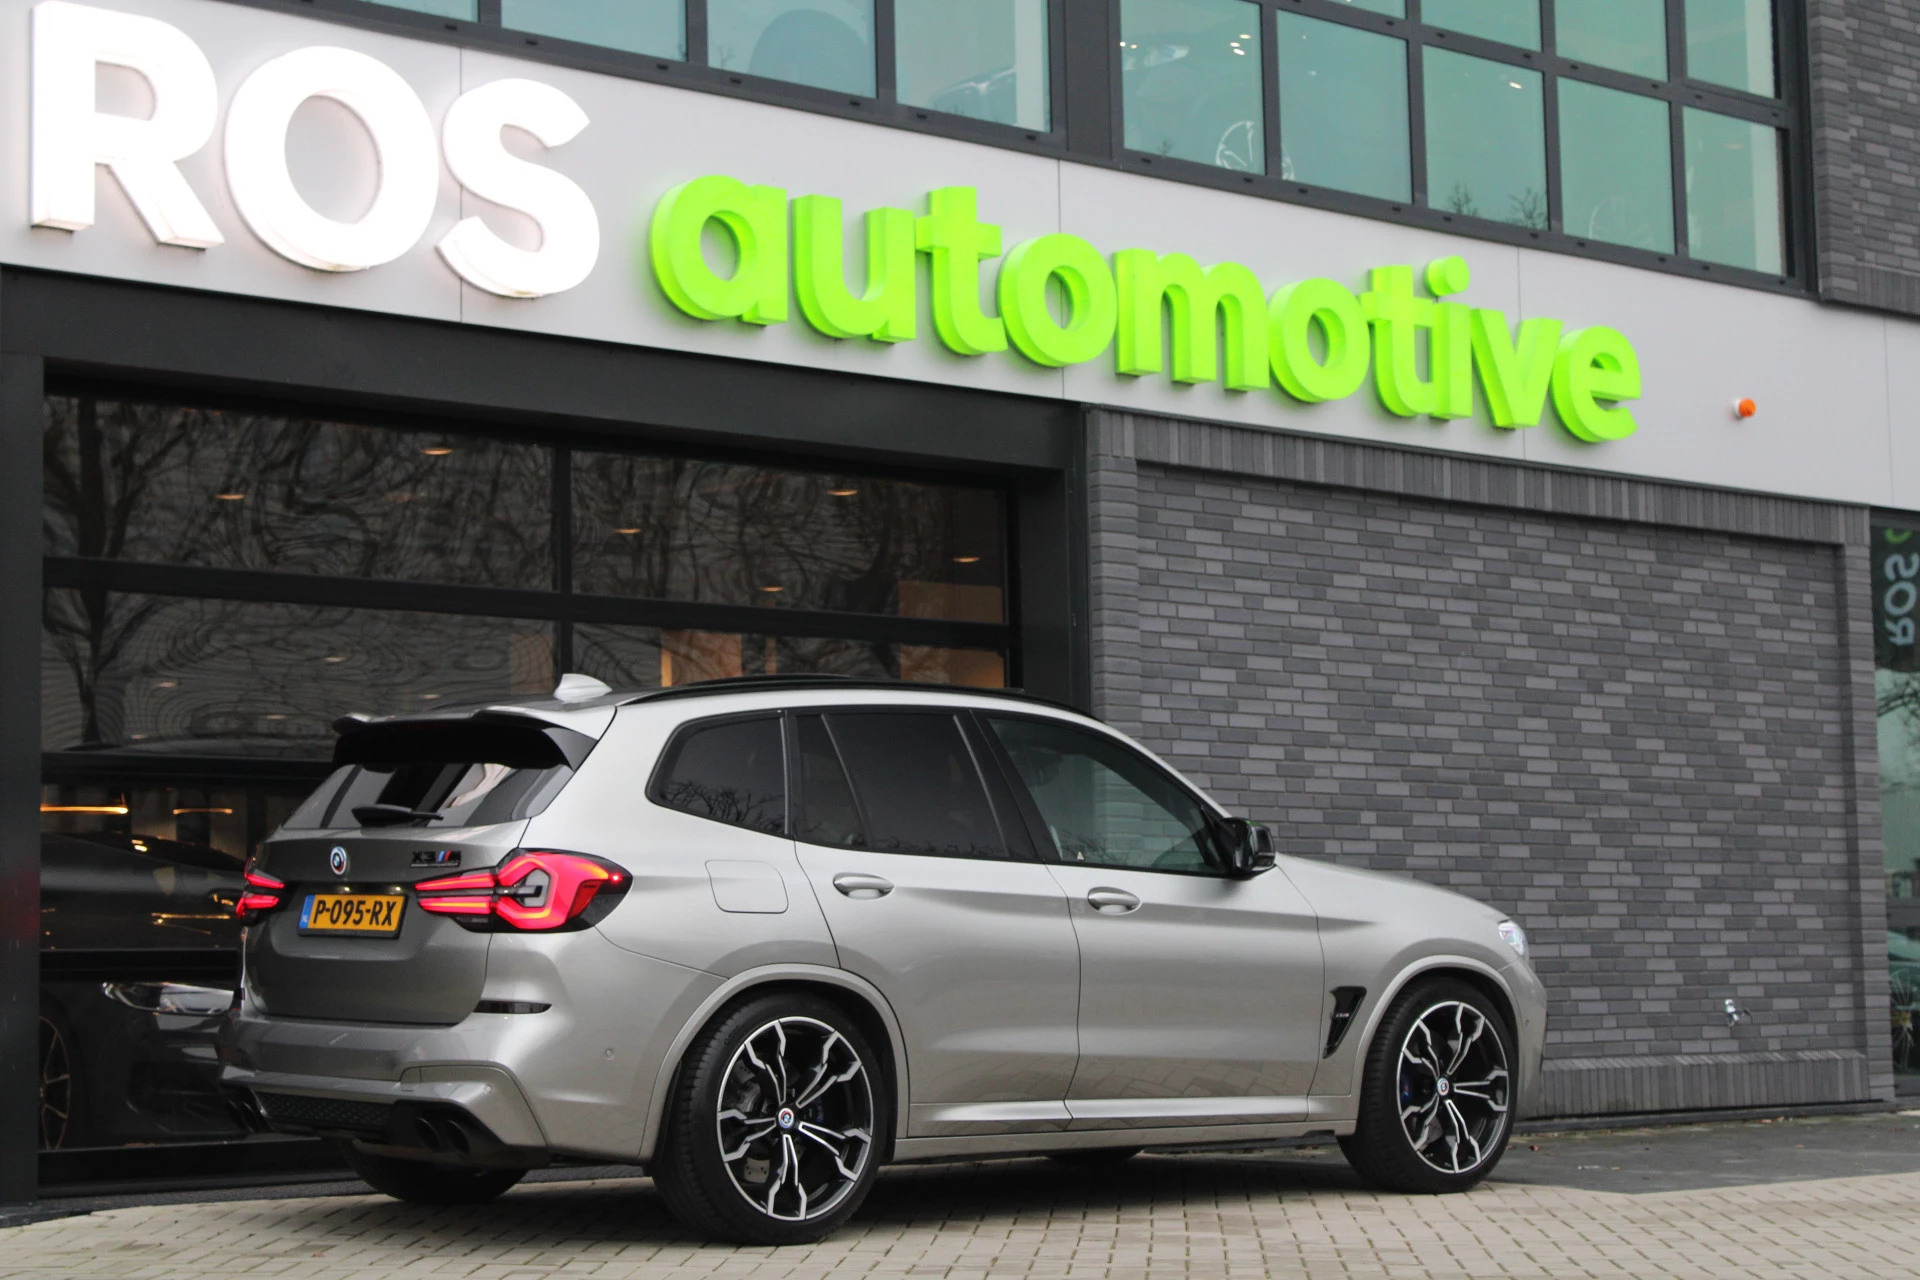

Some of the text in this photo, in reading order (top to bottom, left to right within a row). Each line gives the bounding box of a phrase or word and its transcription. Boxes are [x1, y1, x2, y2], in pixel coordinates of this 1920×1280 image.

[30, 0, 1640, 443] ROS automotive
[313, 900, 396, 926] P-095-RX
